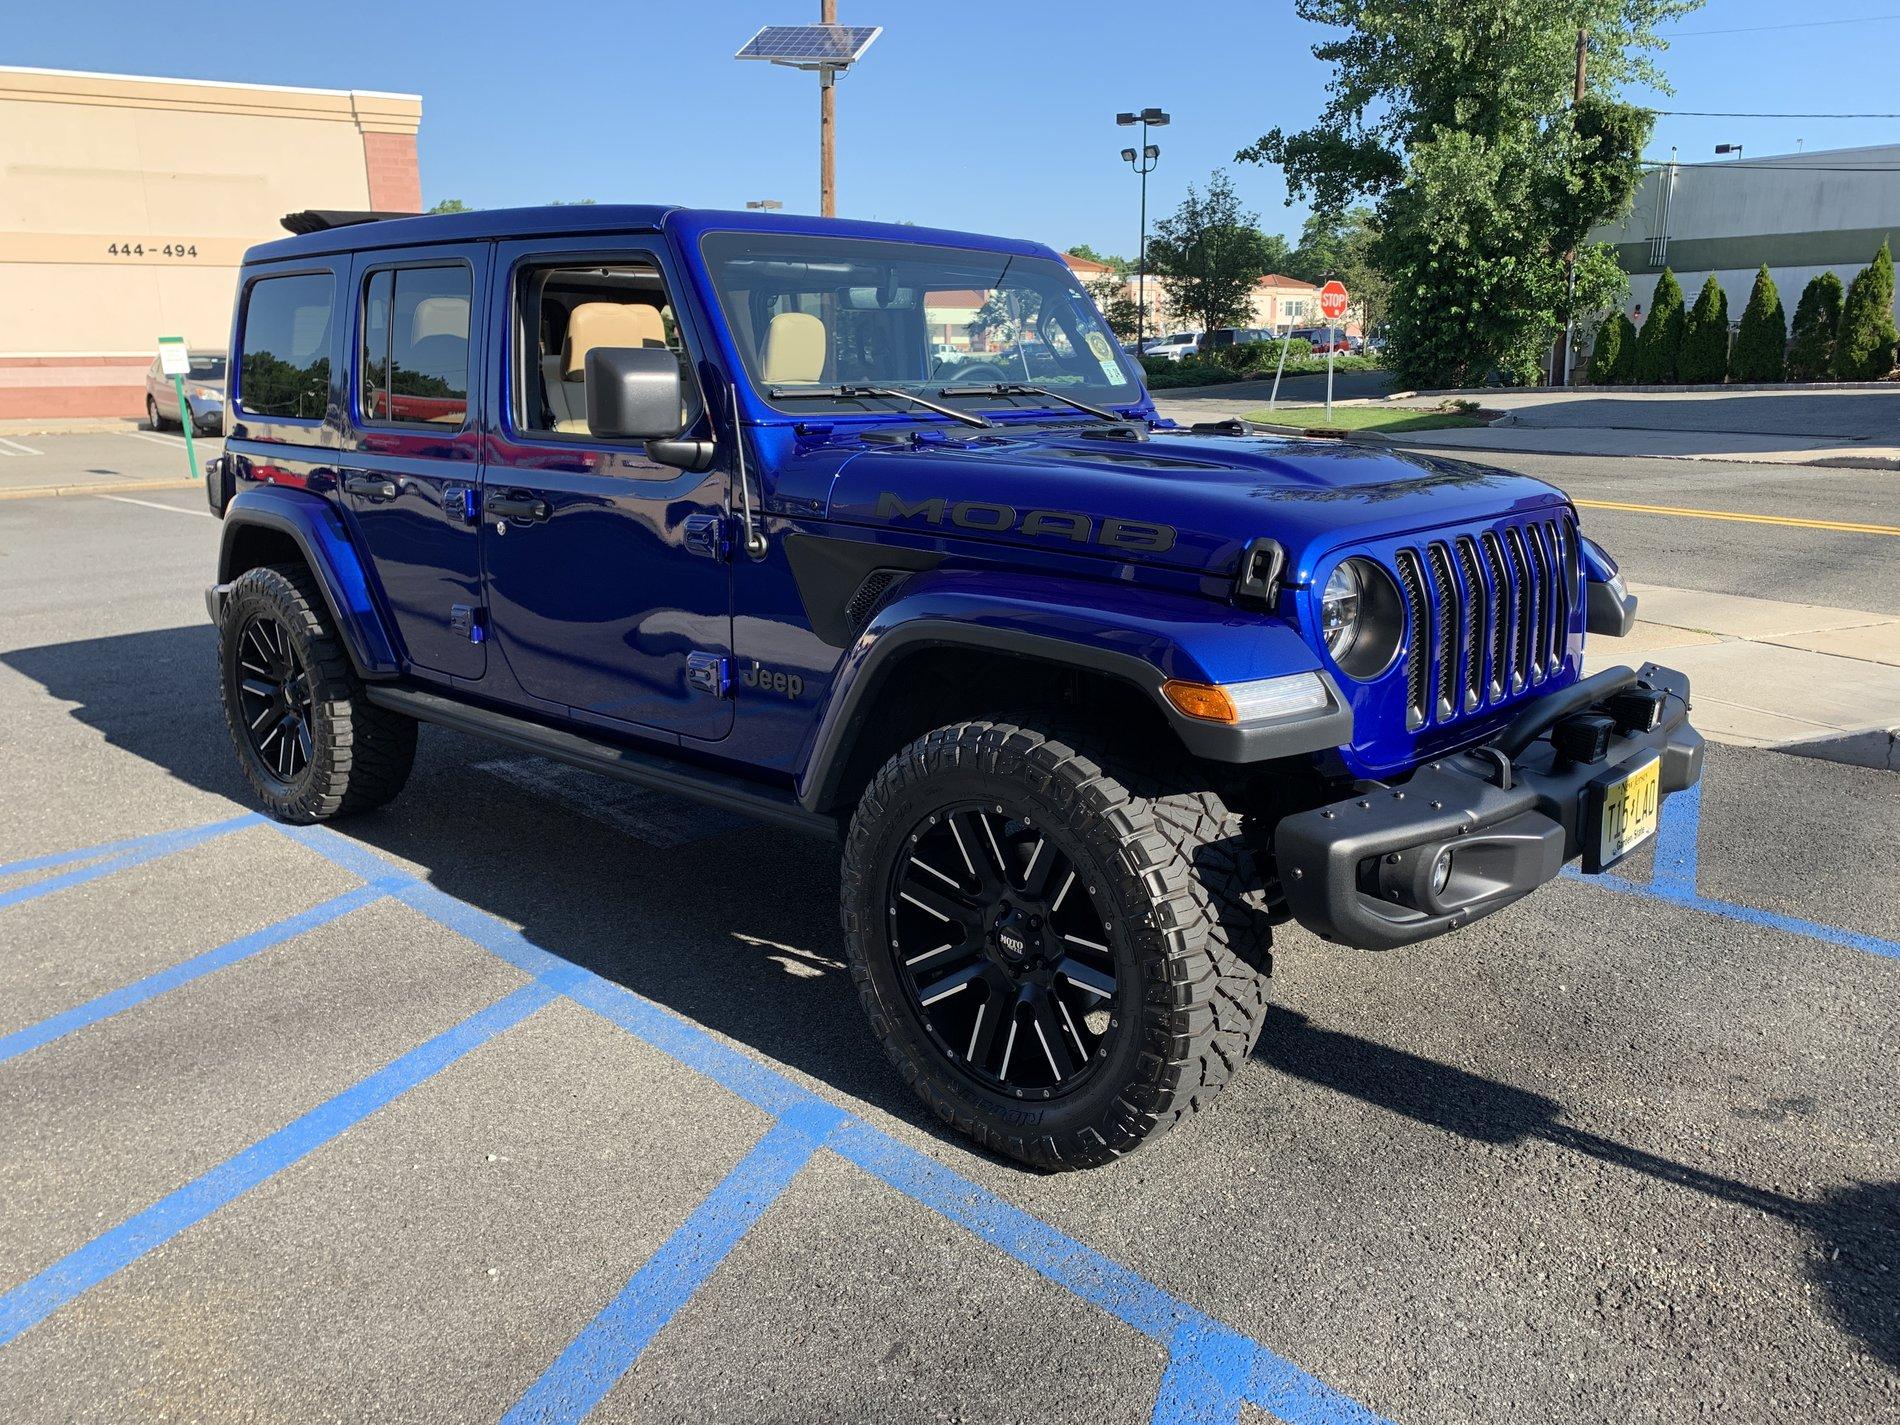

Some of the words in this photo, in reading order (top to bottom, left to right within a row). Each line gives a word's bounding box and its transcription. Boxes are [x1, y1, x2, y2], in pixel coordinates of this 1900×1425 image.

[1322, 293, 1345, 308] STOP
[875, 491, 1177, 553] MOAB
[743, 660, 803, 700] Jeep
